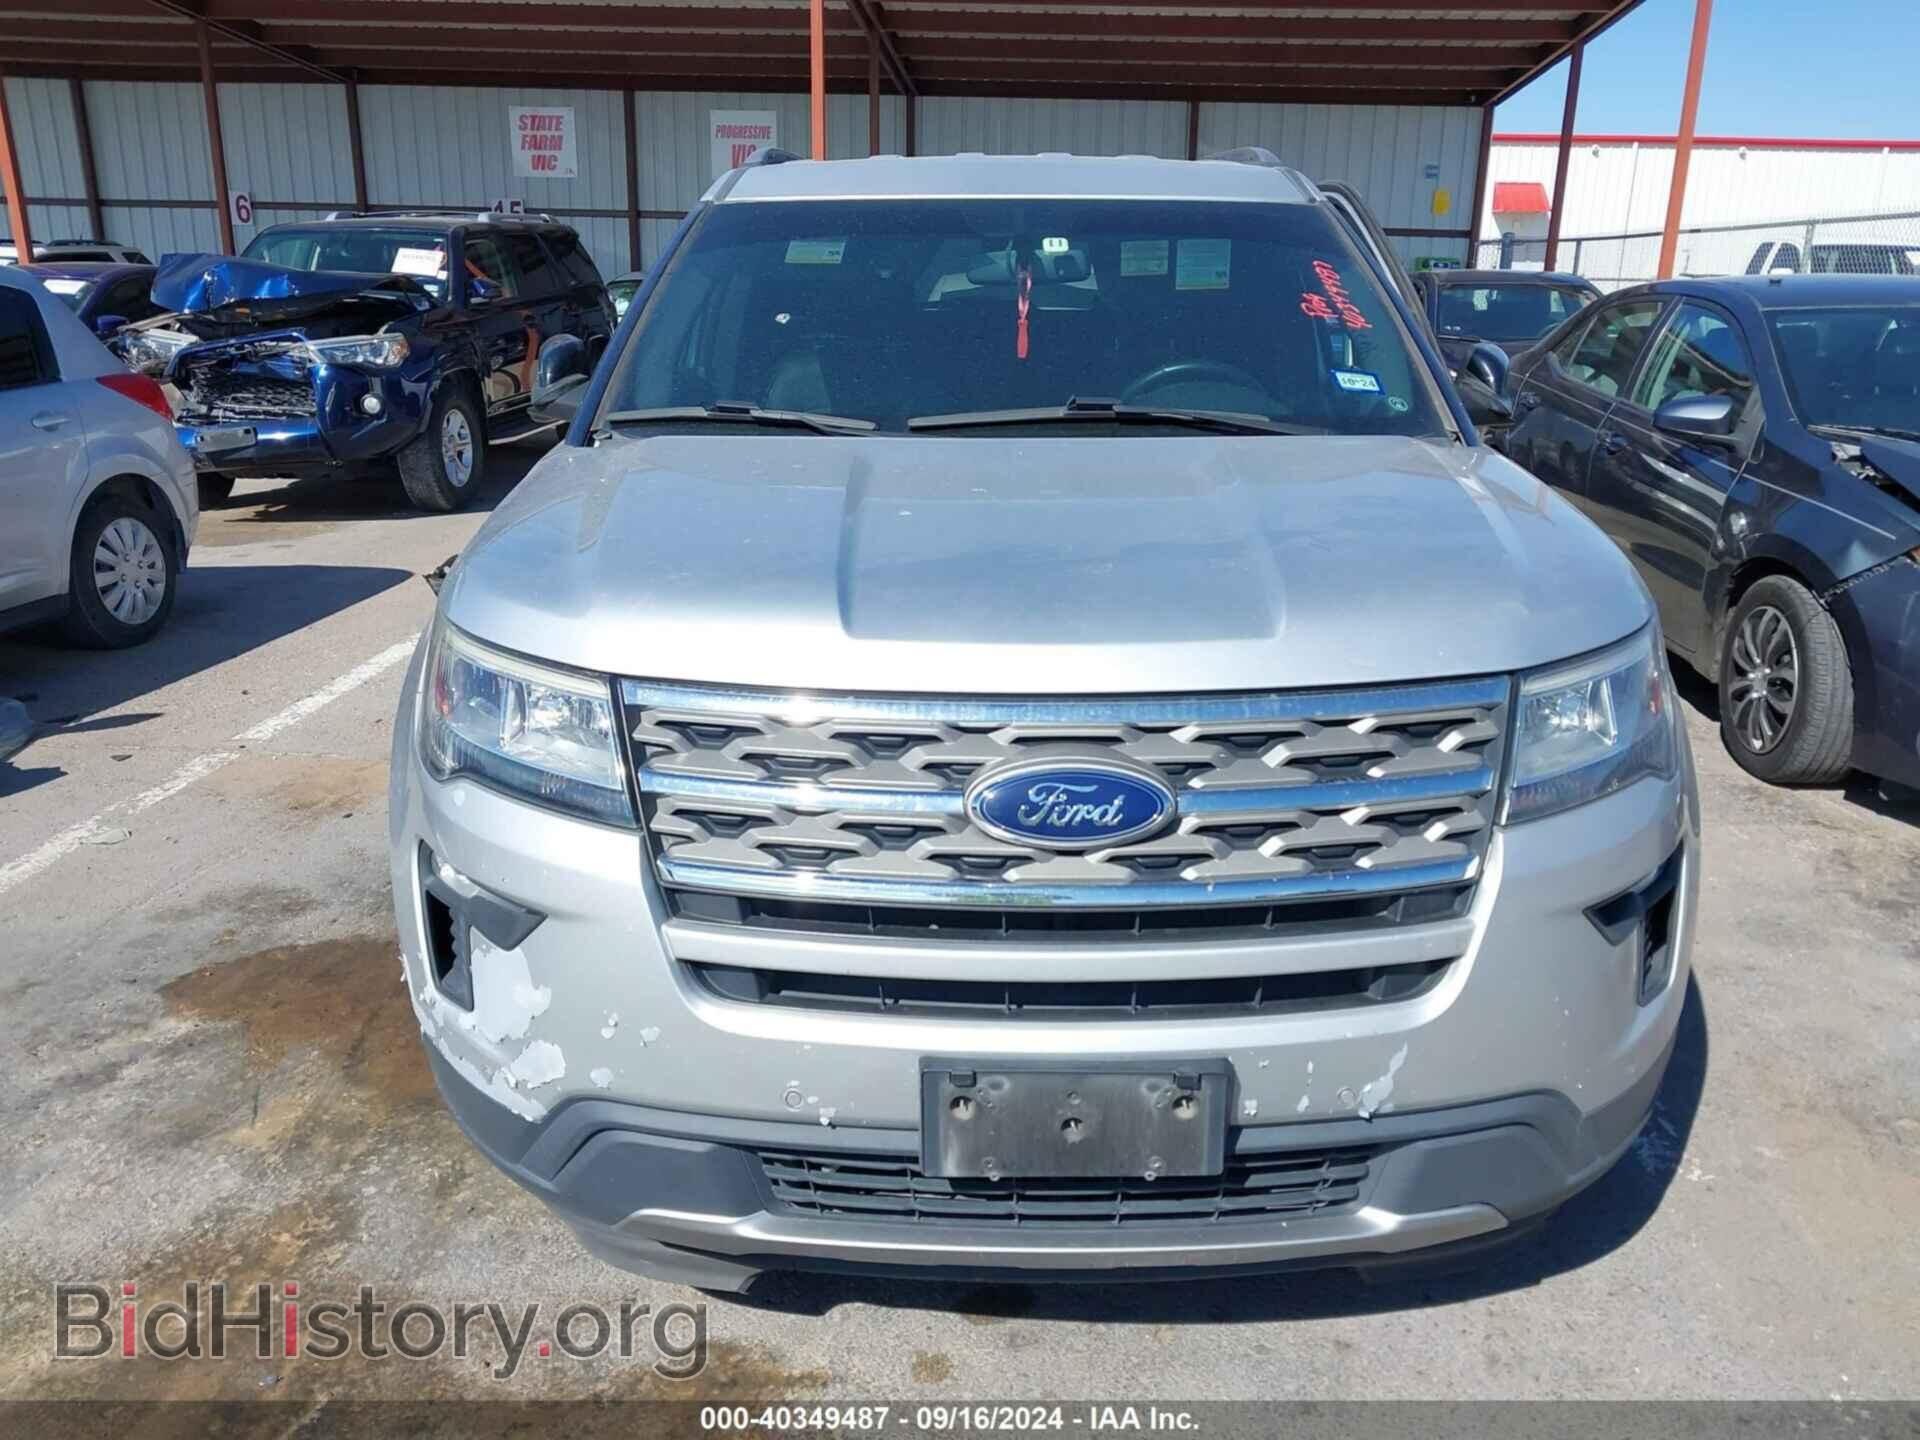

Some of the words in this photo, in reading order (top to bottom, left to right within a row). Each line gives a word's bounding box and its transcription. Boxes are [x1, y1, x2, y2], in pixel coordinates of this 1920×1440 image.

[518, 113, 564, 131] STATE
[715, 124, 772, 140] PROGRESSIVE
[520, 134, 564, 151] FARM
[531, 154, 559, 171] VIC
[1017, 782, 1125, 827] Ford
